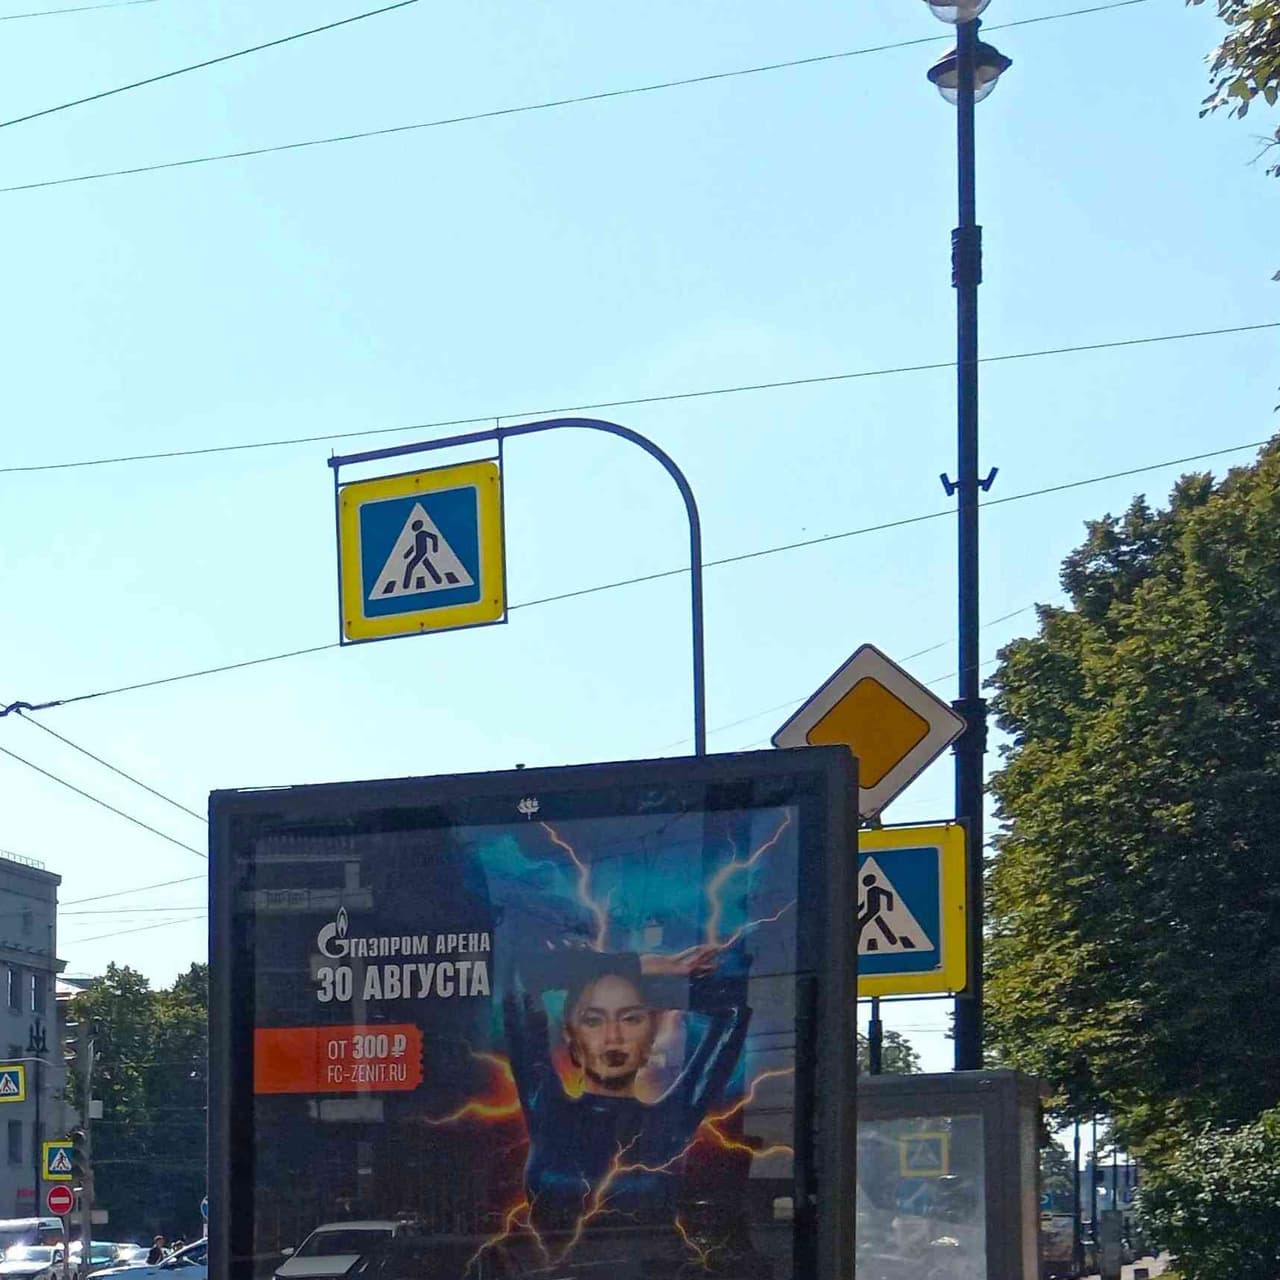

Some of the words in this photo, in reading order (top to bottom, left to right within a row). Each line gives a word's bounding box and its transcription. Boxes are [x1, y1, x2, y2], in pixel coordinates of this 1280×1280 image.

[350, 935, 428, 958] ГАЗПРОМ
[435, 931, 491, 954] АРЕНА
[316, 966, 353, 1003] 30
[363, 960, 491, 1001] АВГУСТА
[327, 1040, 348, 1060] ОТ
[351, 1034, 389, 1060] 300
[327, 1063, 407, 1084] FC-ZENIT.RU
